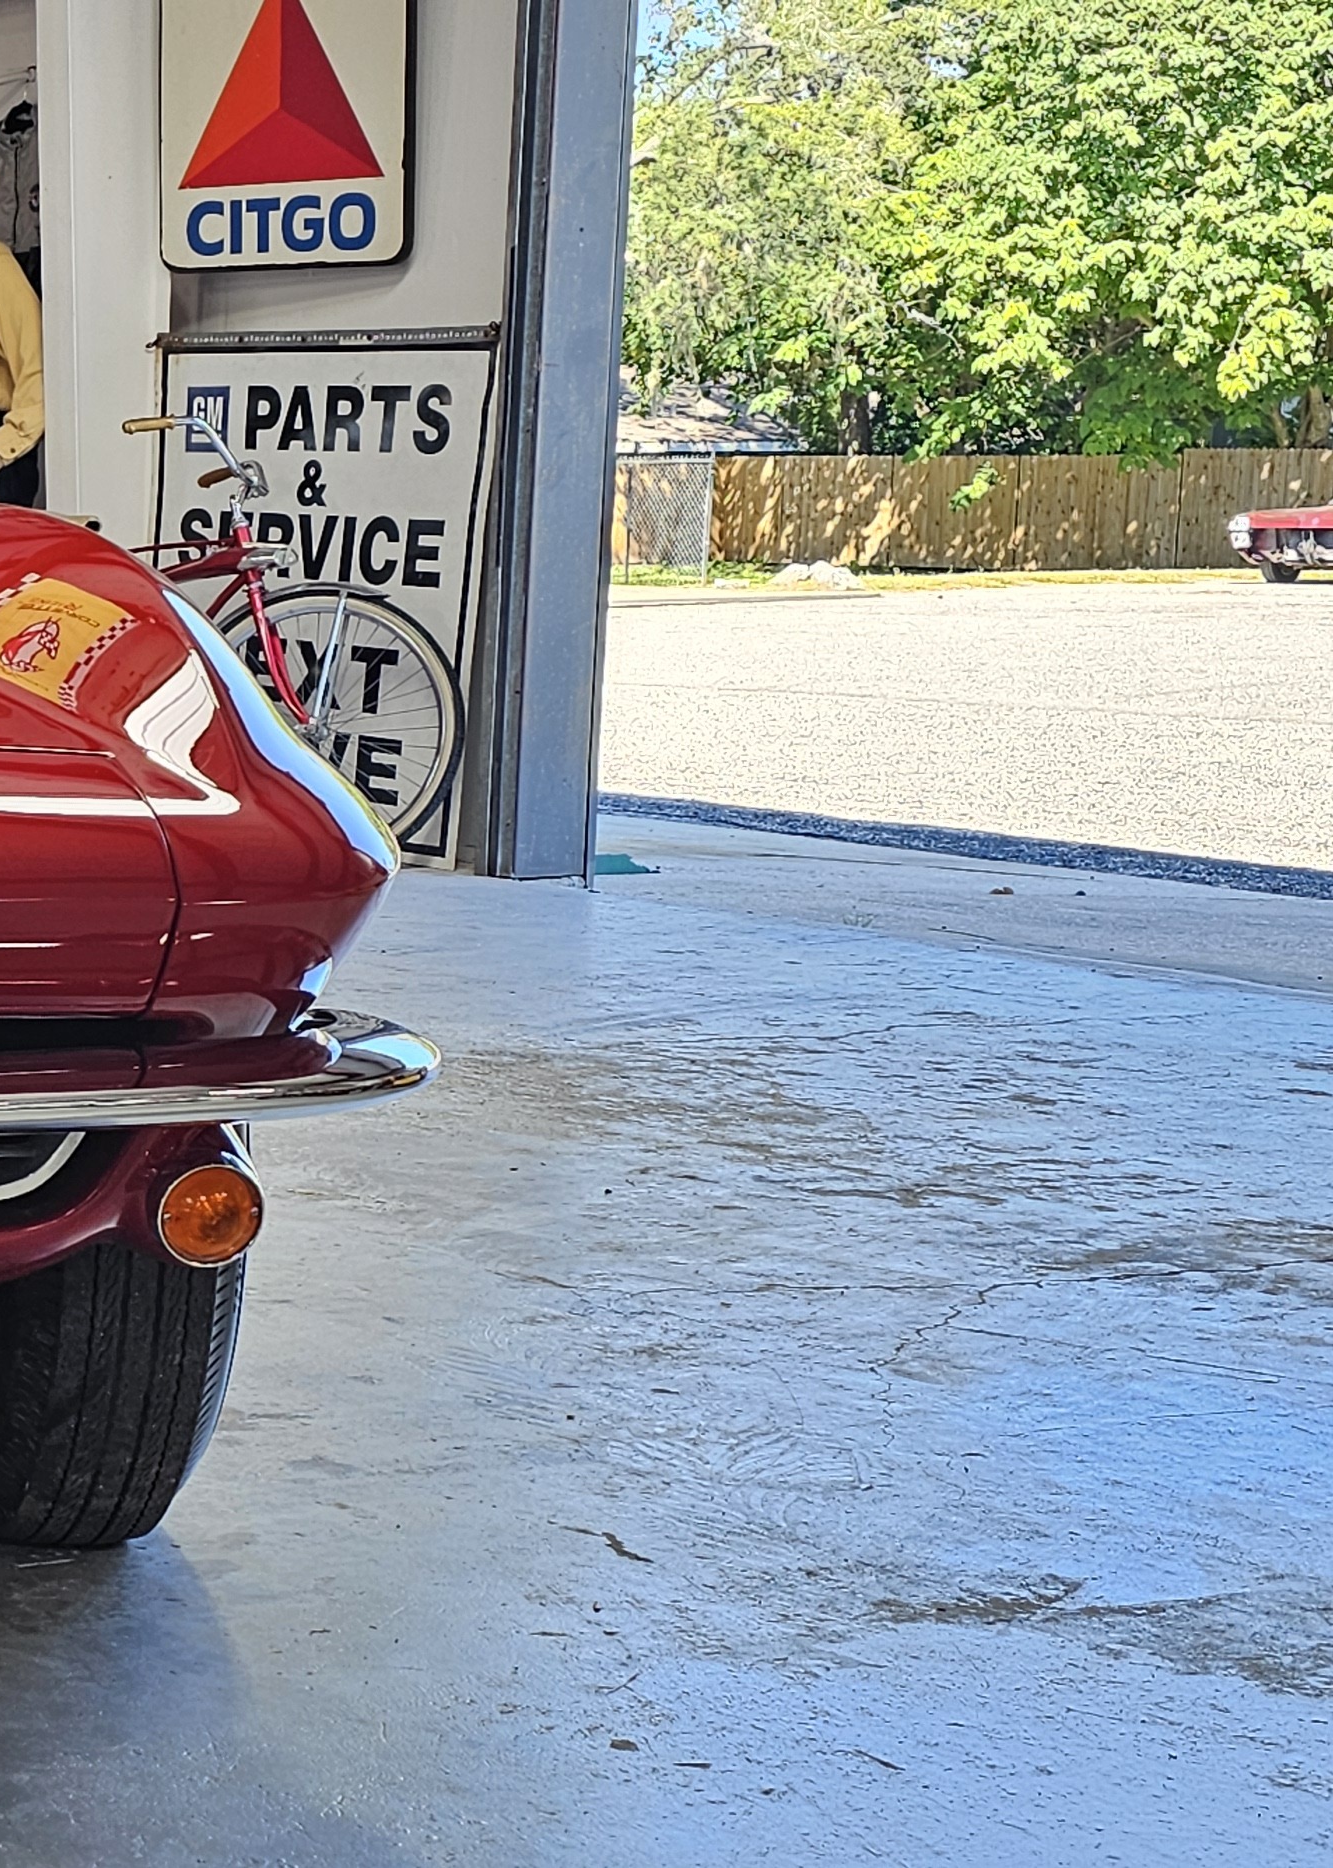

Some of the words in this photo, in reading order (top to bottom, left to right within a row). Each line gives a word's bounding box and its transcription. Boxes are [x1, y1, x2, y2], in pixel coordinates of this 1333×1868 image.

[186, 192, 376, 257] CITGO
[191, 395, 224, 435] GM
[244, 383, 453, 455] PARTS
[296, 459, 327, 507] &
